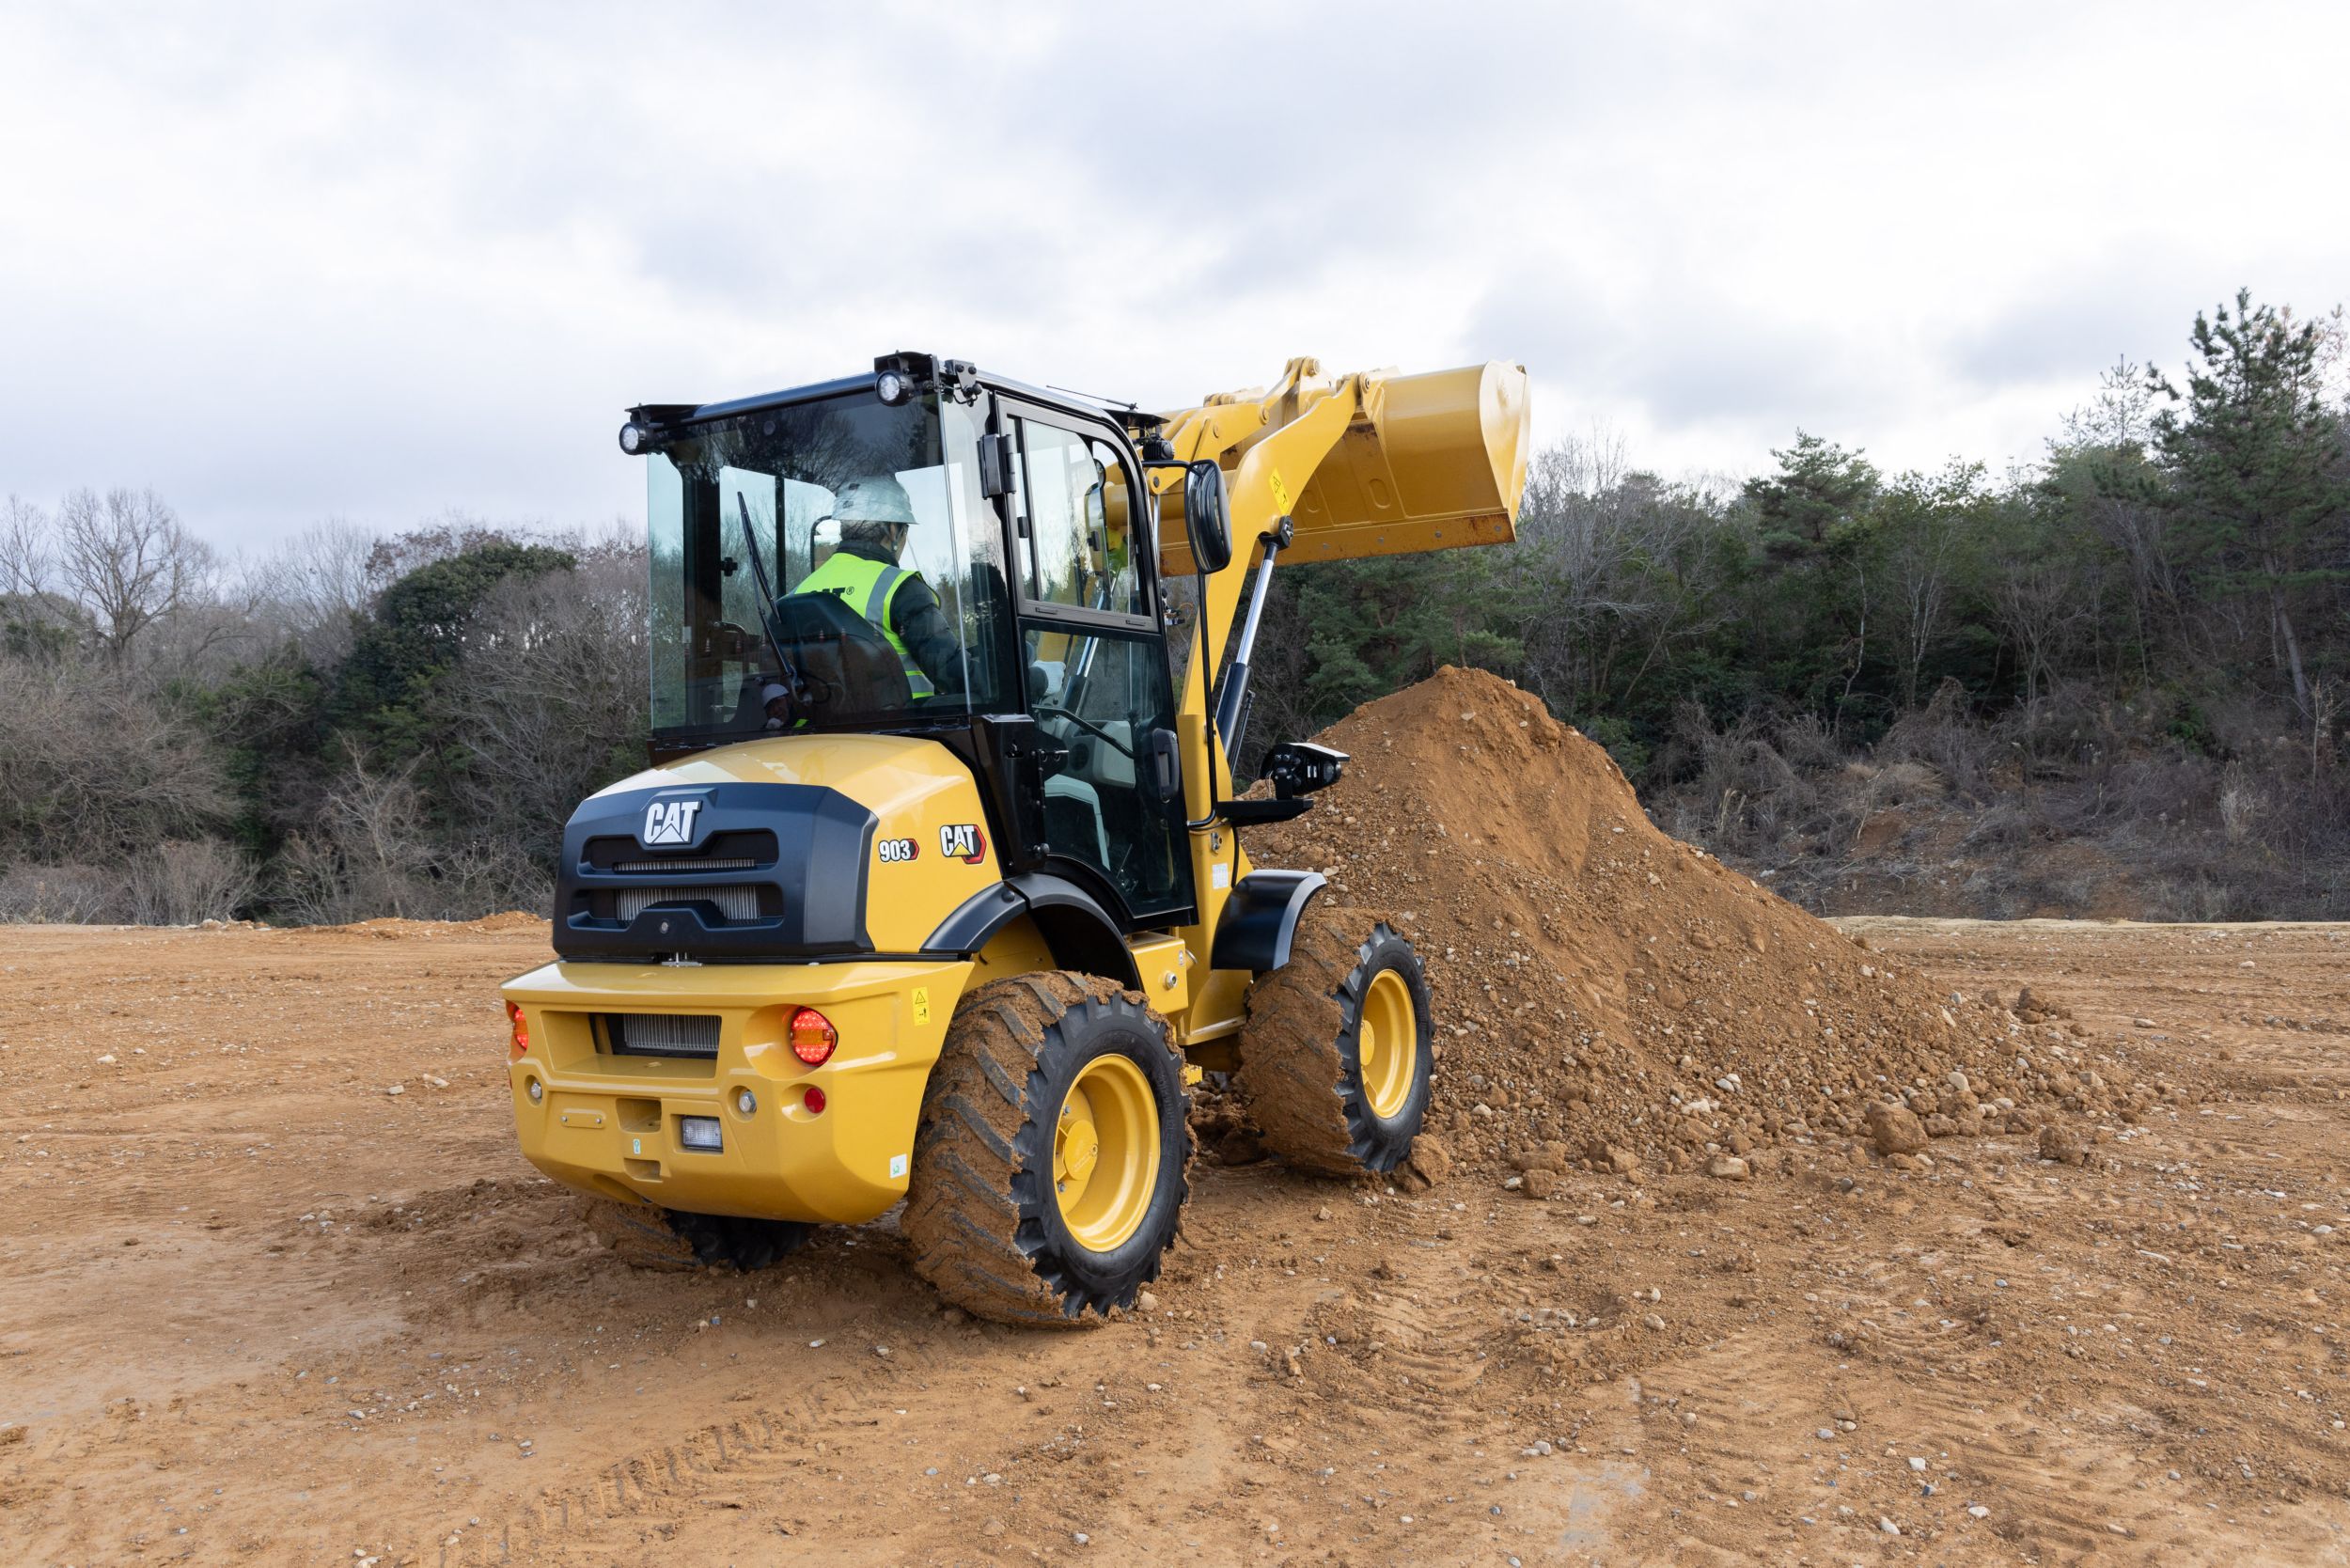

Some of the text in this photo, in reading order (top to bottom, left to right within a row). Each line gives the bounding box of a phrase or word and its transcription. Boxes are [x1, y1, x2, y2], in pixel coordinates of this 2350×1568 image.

[644, 801, 700, 844] CAT
[879, 839, 911, 862] 903
[940, 824, 975, 856] CAT
